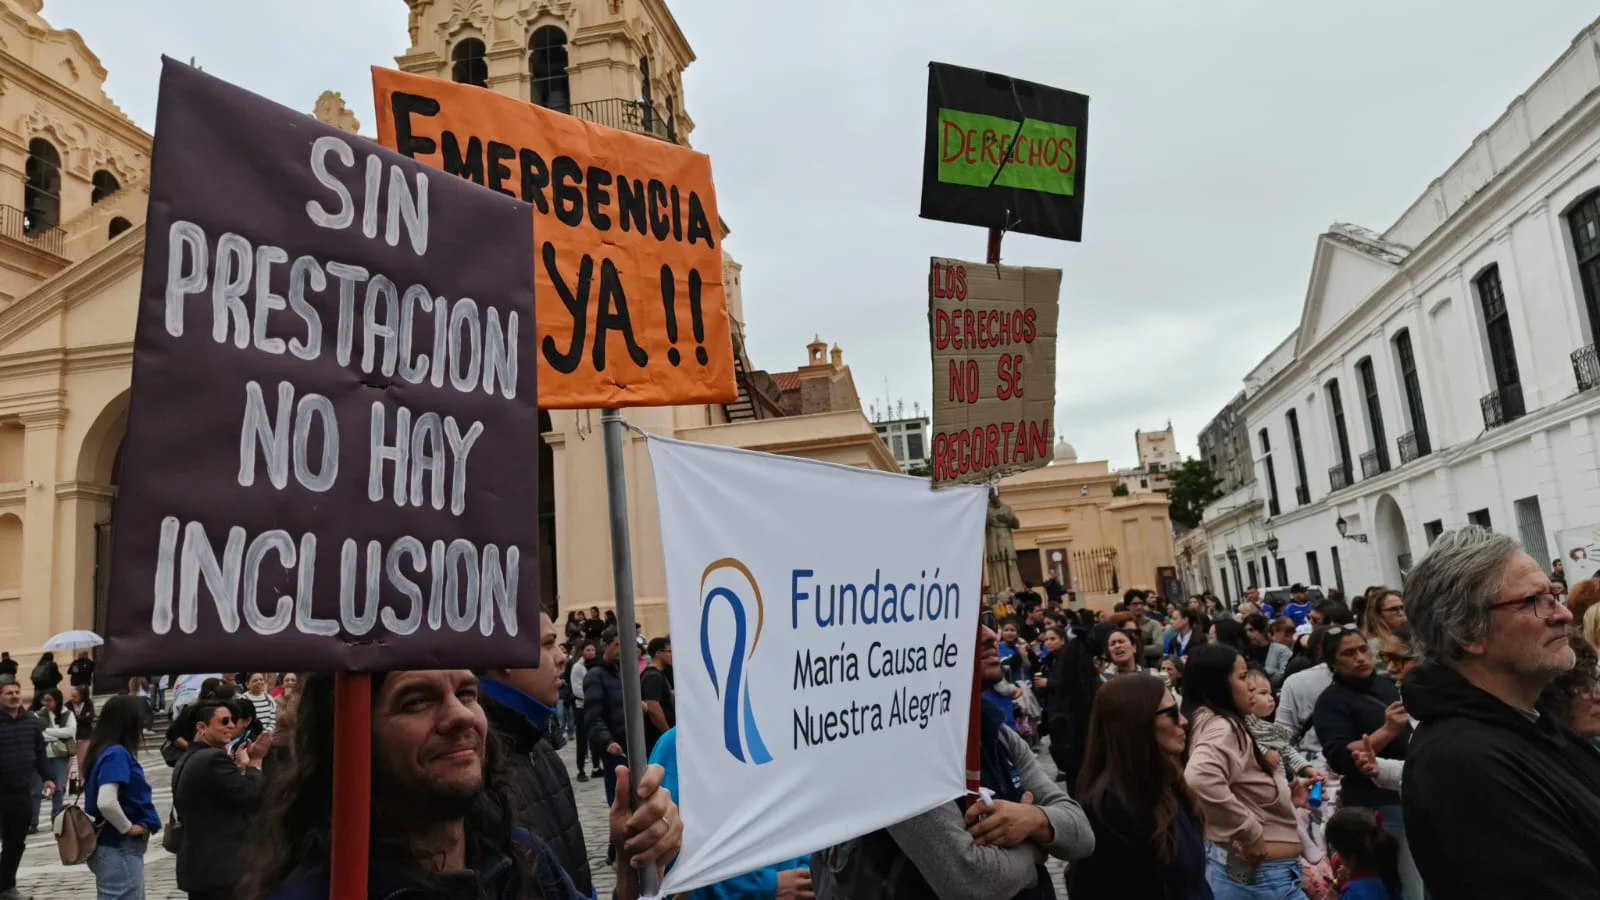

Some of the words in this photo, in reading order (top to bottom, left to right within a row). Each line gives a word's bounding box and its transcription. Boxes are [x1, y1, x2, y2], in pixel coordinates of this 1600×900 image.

[391, 91, 715, 249] EMERGENCIA
[942, 119, 1073, 174] DERECHOS
[305, 136, 429, 256] SIN
[165, 220, 519, 400] PRESTACION
[934, 262, 968, 301] LOS
[935, 308, 1037, 350] DERECHOS
[949, 359, 980, 404] NO
[997, 353, 1024, 401] SE
[237, 380, 340, 492] NO
[367, 401, 484, 516] HAY
[933, 419, 1049, 482] RECORTAN
[151, 516, 520, 638] INCLUSION
[791, 567, 960, 630] Fundación
[793, 641, 860, 691] María
[867, 641, 927, 679] Causa
[933, 633, 958, 669] de
[793, 700, 883, 751] Nuestra
[888, 681, 952, 730] Alegría
